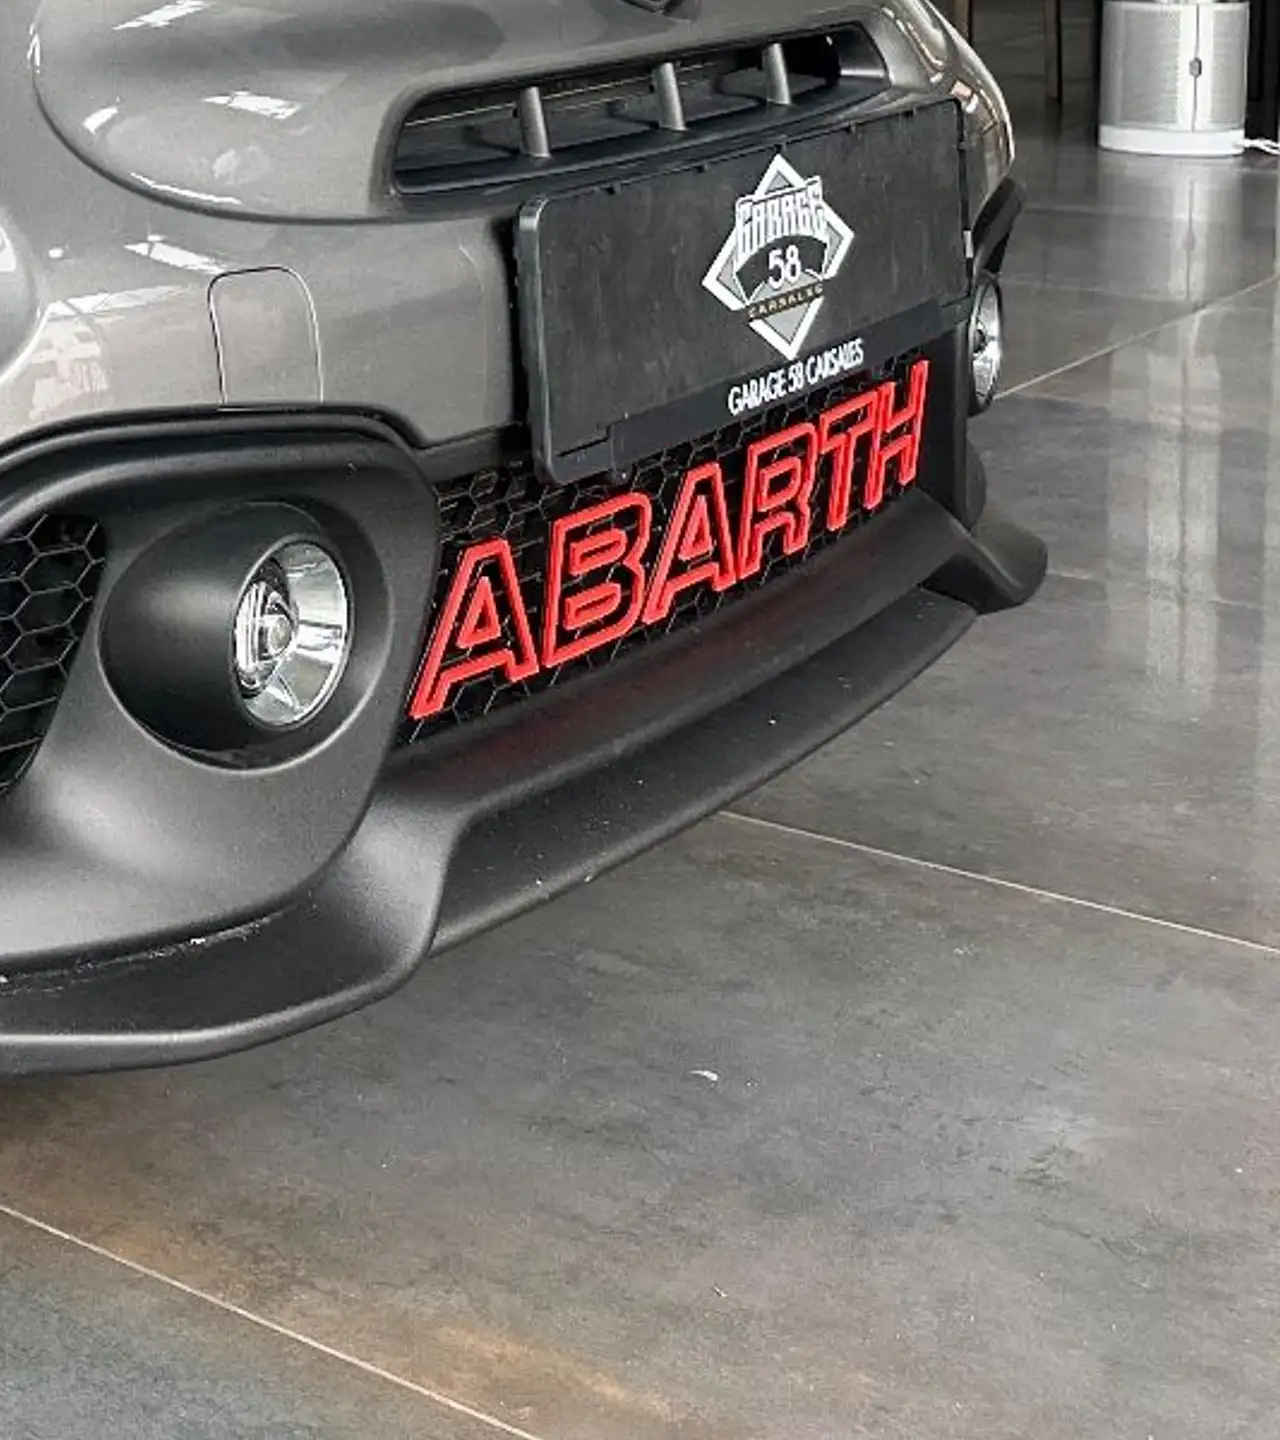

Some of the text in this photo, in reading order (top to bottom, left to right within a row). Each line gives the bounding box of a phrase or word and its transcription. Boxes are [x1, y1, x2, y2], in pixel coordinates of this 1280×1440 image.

[767, 244, 801, 290] 58
[727, 368, 787, 416] GARAGE
[787, 360, 804, 393] 58
[406, 359, 931, 721] ABARTH
